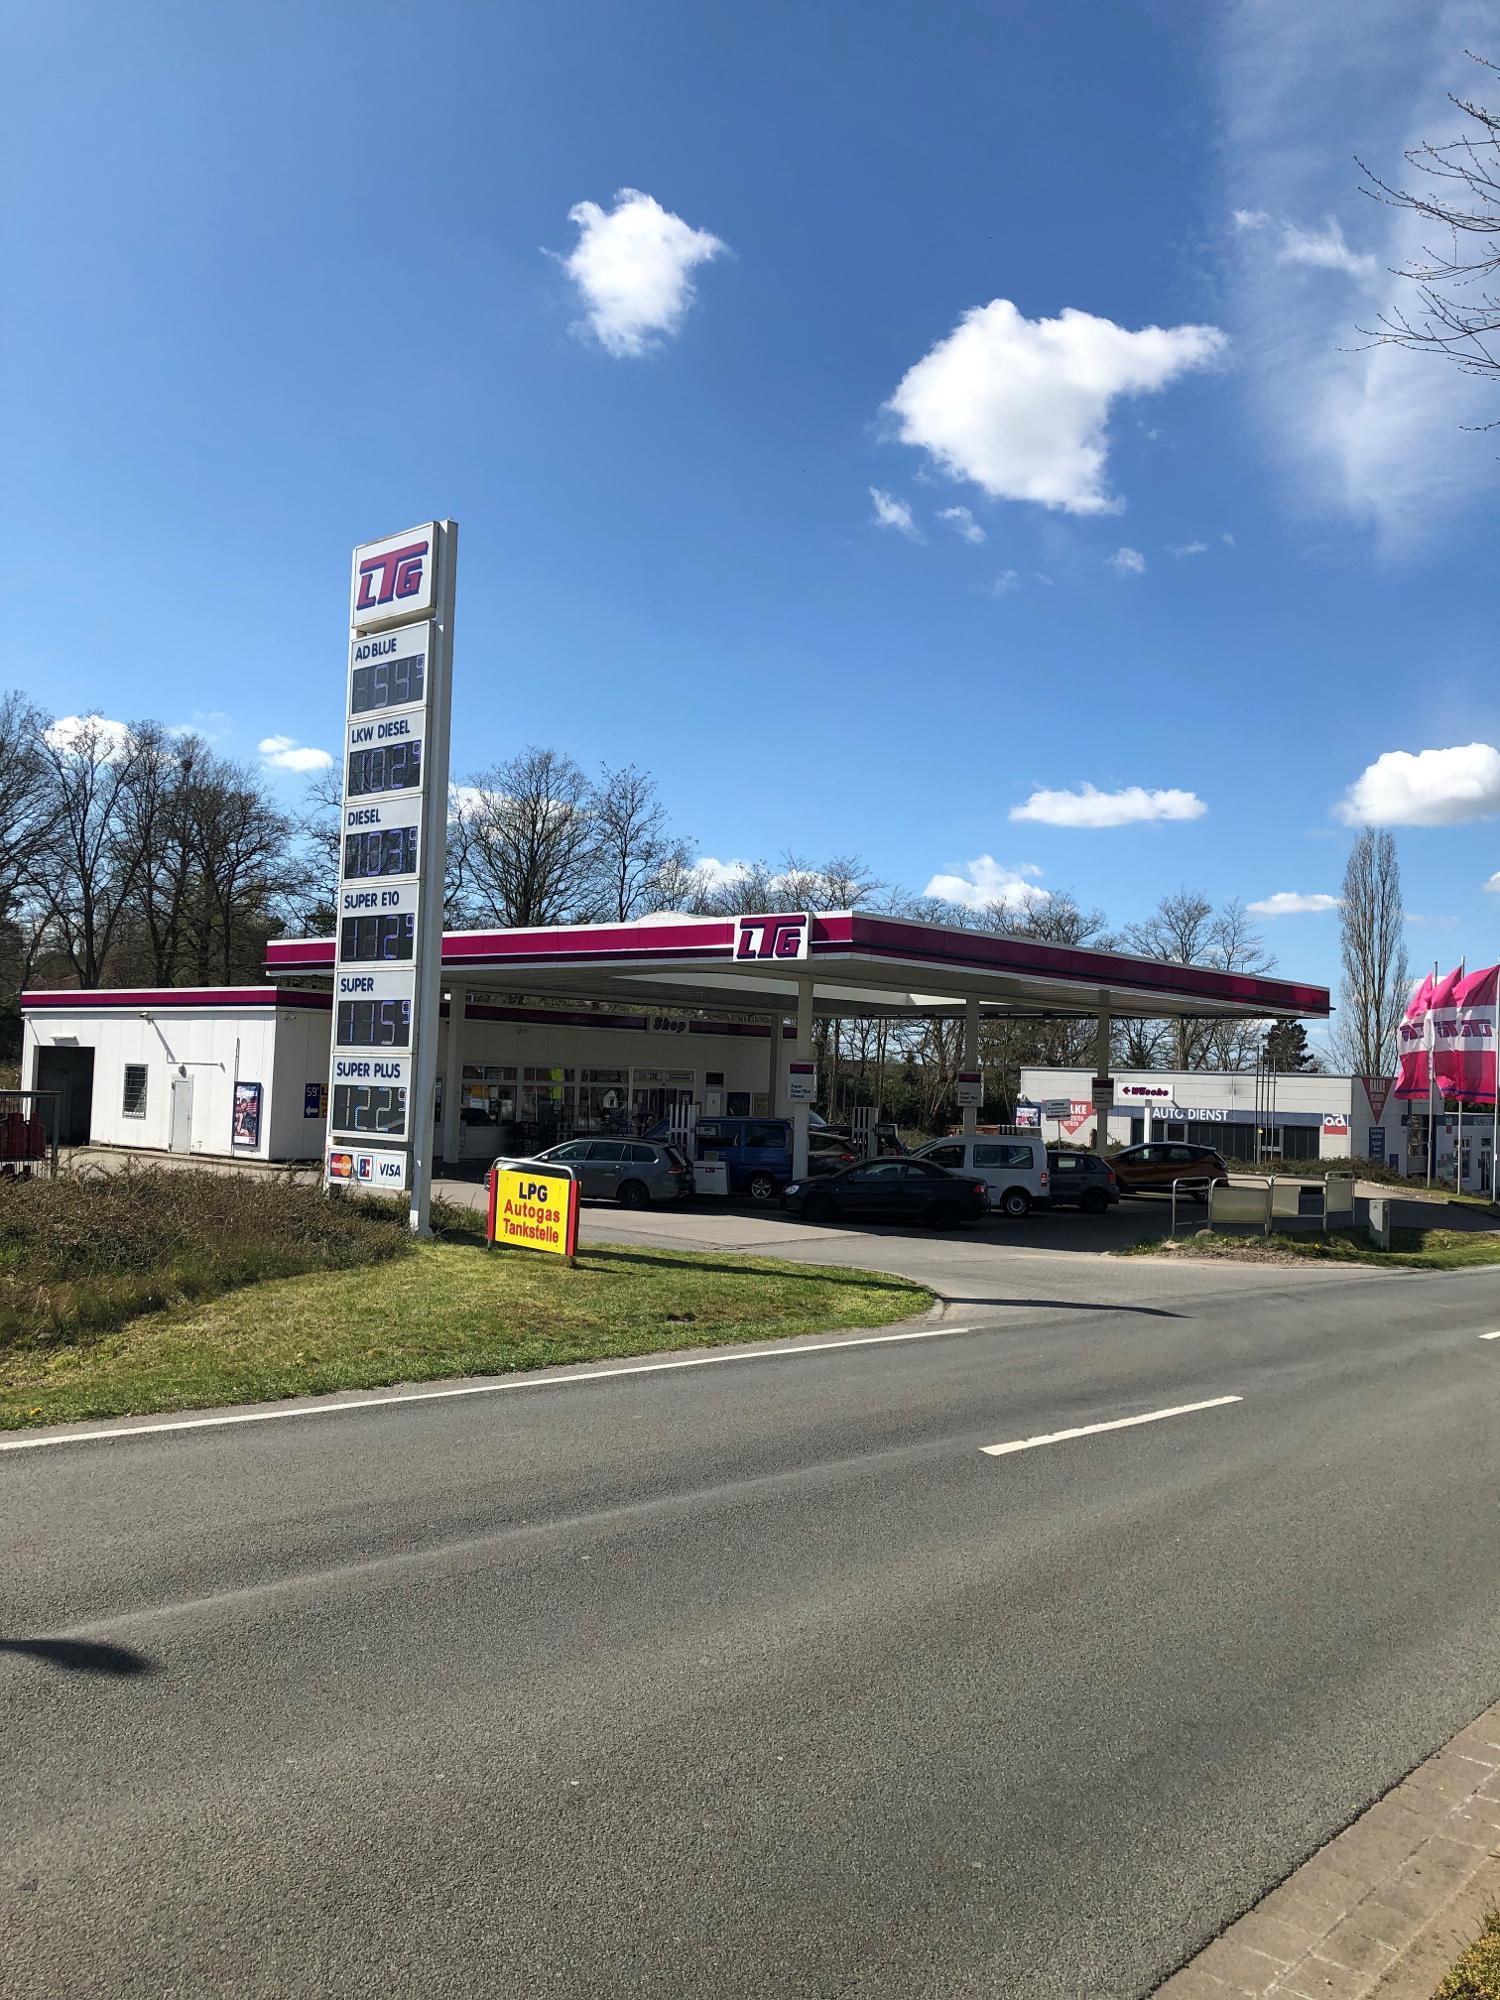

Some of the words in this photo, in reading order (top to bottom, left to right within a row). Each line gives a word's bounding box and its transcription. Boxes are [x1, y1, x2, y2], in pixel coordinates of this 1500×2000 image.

[356, 541, 429, 611] LTG
[352, 726, 374, 744] LKW
[377, 719, 410, 739] DIESEL
[348, 808, 381, 826] DIESEL
[344, 892, 378, 910] SUPER
[381, 891, 400, 907] E10
[736, 915, 807, 959] LTG
[340, 977, 374, 993] SUPER
[653, 1016, 686, 1033] Shop
[336, 1062, 370, 1078] SUPER
[374, 1062, 401, 1079] PLUS
[1152, 1108, 1185, 1120] AUTO
[1188, 1109, 1228, 1121] DIENST
[380, 1163, 401, 1177] VISA
[519, 1182, 548, 1203] LPG
[504, 1199, 561, 1224] Autogas
[503, 1218, 559, 1244] Tankstelle
